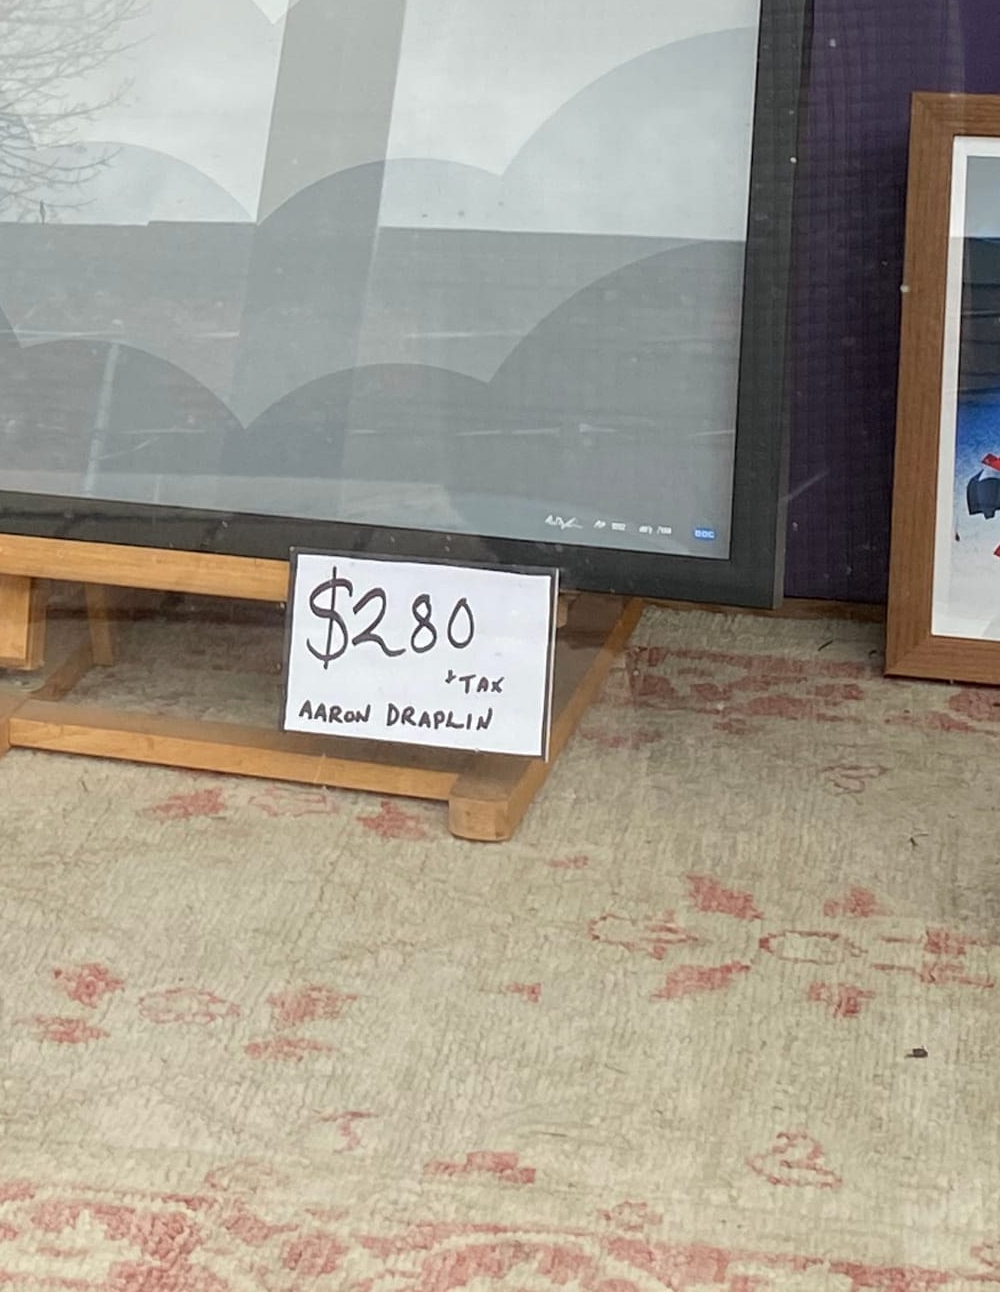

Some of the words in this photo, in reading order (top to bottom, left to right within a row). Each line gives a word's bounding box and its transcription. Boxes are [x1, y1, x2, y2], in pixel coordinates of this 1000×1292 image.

[306, 566, 475, 670] $280
[298, 699, 371, 723] AARON
[386, 702, 493, 731] DRAPLIN
